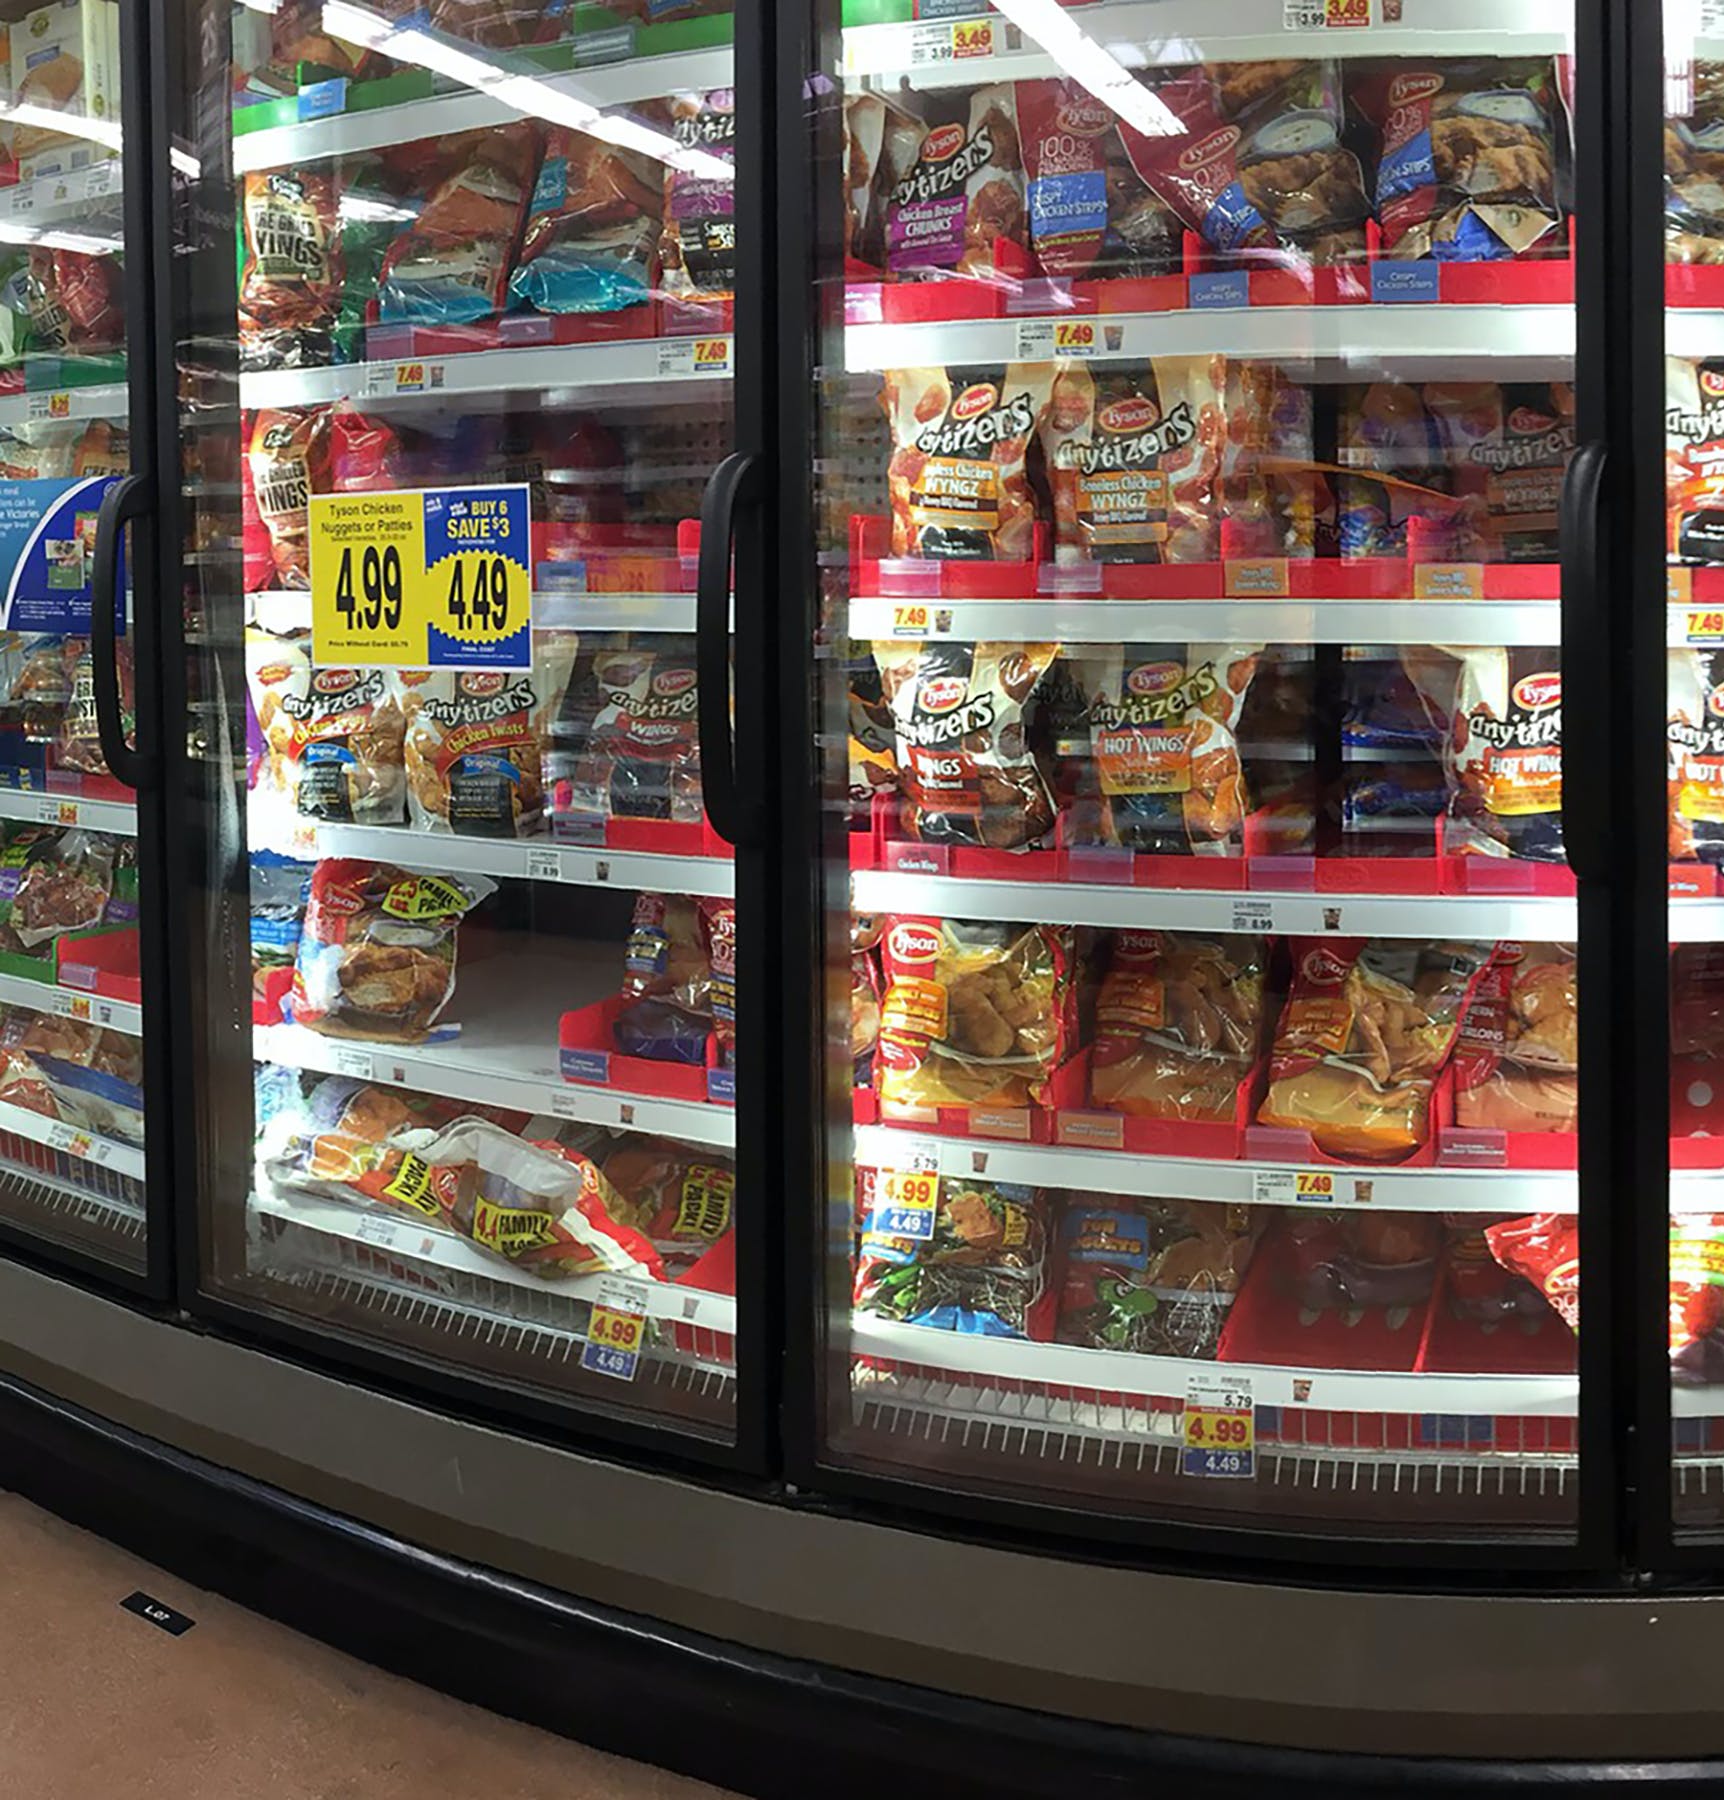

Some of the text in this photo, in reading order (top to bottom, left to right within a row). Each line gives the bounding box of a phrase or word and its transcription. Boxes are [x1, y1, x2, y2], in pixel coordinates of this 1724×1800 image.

[1327, 0, 1369, 17] 3.49
[1301, 13, 1324, 26] 3.99
[955, 27, 992, 48] 3.49
[1392, 76, 1438, 97] Tyson
[1032, 204, 1075, 221] CHICKEN
[905, 217, 951, 238] CHUNKS
[1056, 325, 1093, 345] 7.49
[695, 342, 726, 360] 7.49
[397, 366, 423, 383] 7.49
[925, 478, 979, 496] WYNGZ
[471, 501, 496, 516] BUY
[499, 500, 508, 514] 6
[1091, 491, 1147, 509] WYNGZ
[329, 502, 403, 519] Tyson Chicken
[321, 519, 413, 536] Nuggets or Patties
[447, 518, 490, 539] SAVE
[336, 545, 402, 630] 4.99
[448, 557, 508, 631] 4.49
[895, 608, 926, 625] 7.49
[1687, 613, 1724, 632] 7.49
[328, 640, 345, 648] Price
[346, 640, 370, 648] Without
[1137, 668, 1181, 687] Tyson
[446, 721, 526, 753] Chicken Twists
[630, 721, 681, 738] WINGS
[1105, 738, 1132, 754] HOT
[1251, 918, 1273, 931] 8.99
[894, 932, 940, 955] Tyson
[885, 1179, 931, 1204] 4.99
[1298, 1175, 1331, 1192] 7.49
[889, 1215, 921, 1234] 4.49
[594, 1314, 636, 1345] 4.99
[597, 1350, 624, 1372] 4.49
[1225, 1395, 1252, 1408] 5.79
[1188, 1416, 1247, 1443] 4.99
[1206, 1455, 1240, 1472] 4.49
